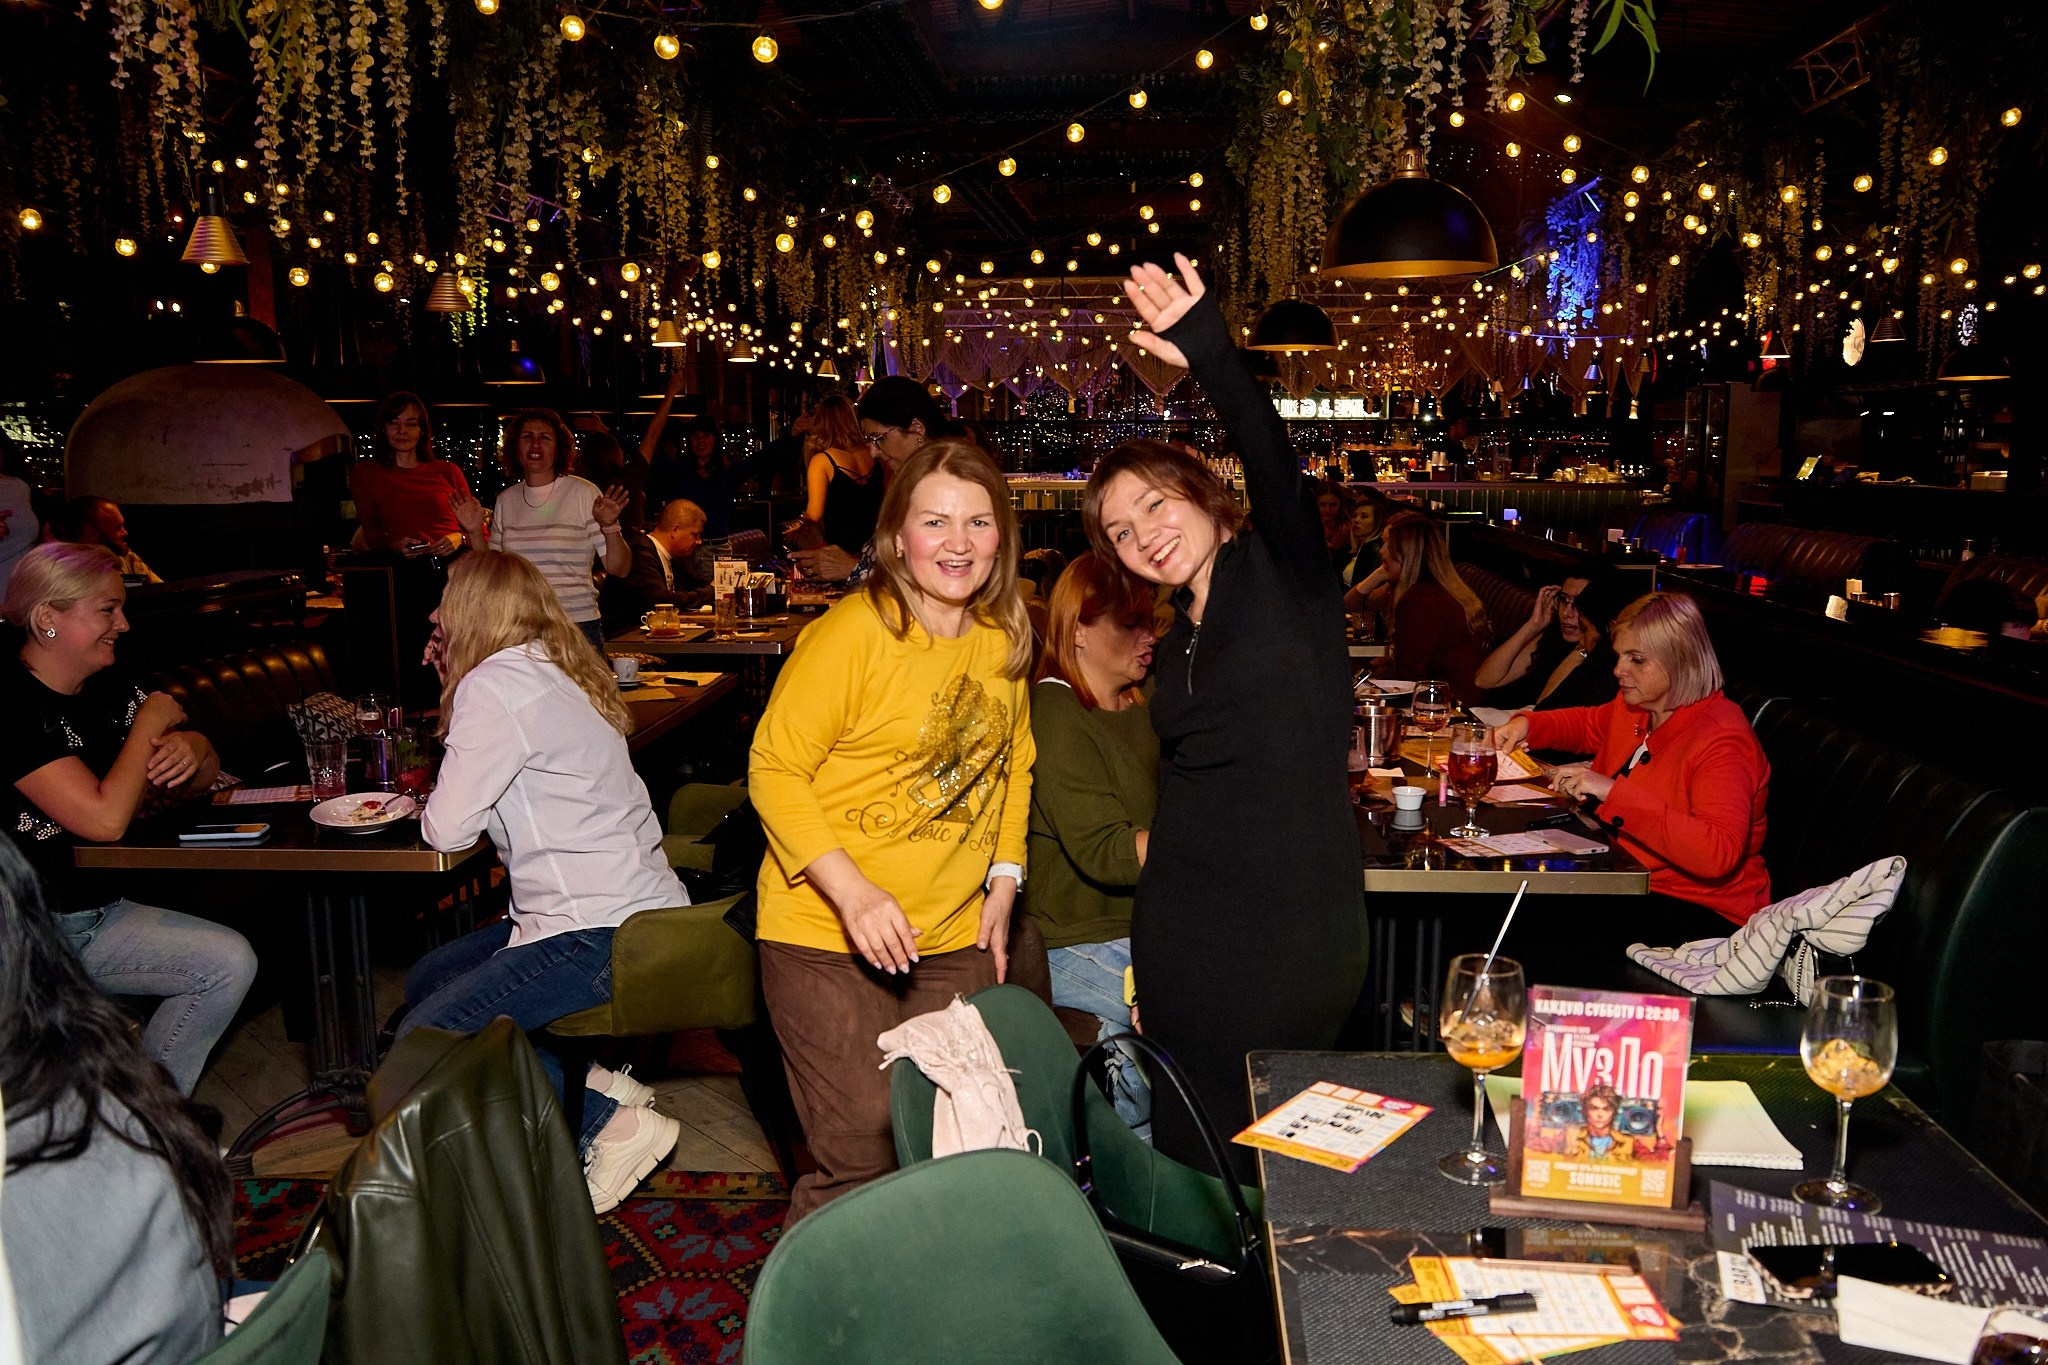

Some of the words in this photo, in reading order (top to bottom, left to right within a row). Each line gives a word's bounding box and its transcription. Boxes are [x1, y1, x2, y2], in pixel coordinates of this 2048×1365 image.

[1534, 999, 1584, 1016] КАЖДУЮ
[1585, 1002, 1636, 1019] СУББОТУ
[1635, 1006, 1645, 1020] В
